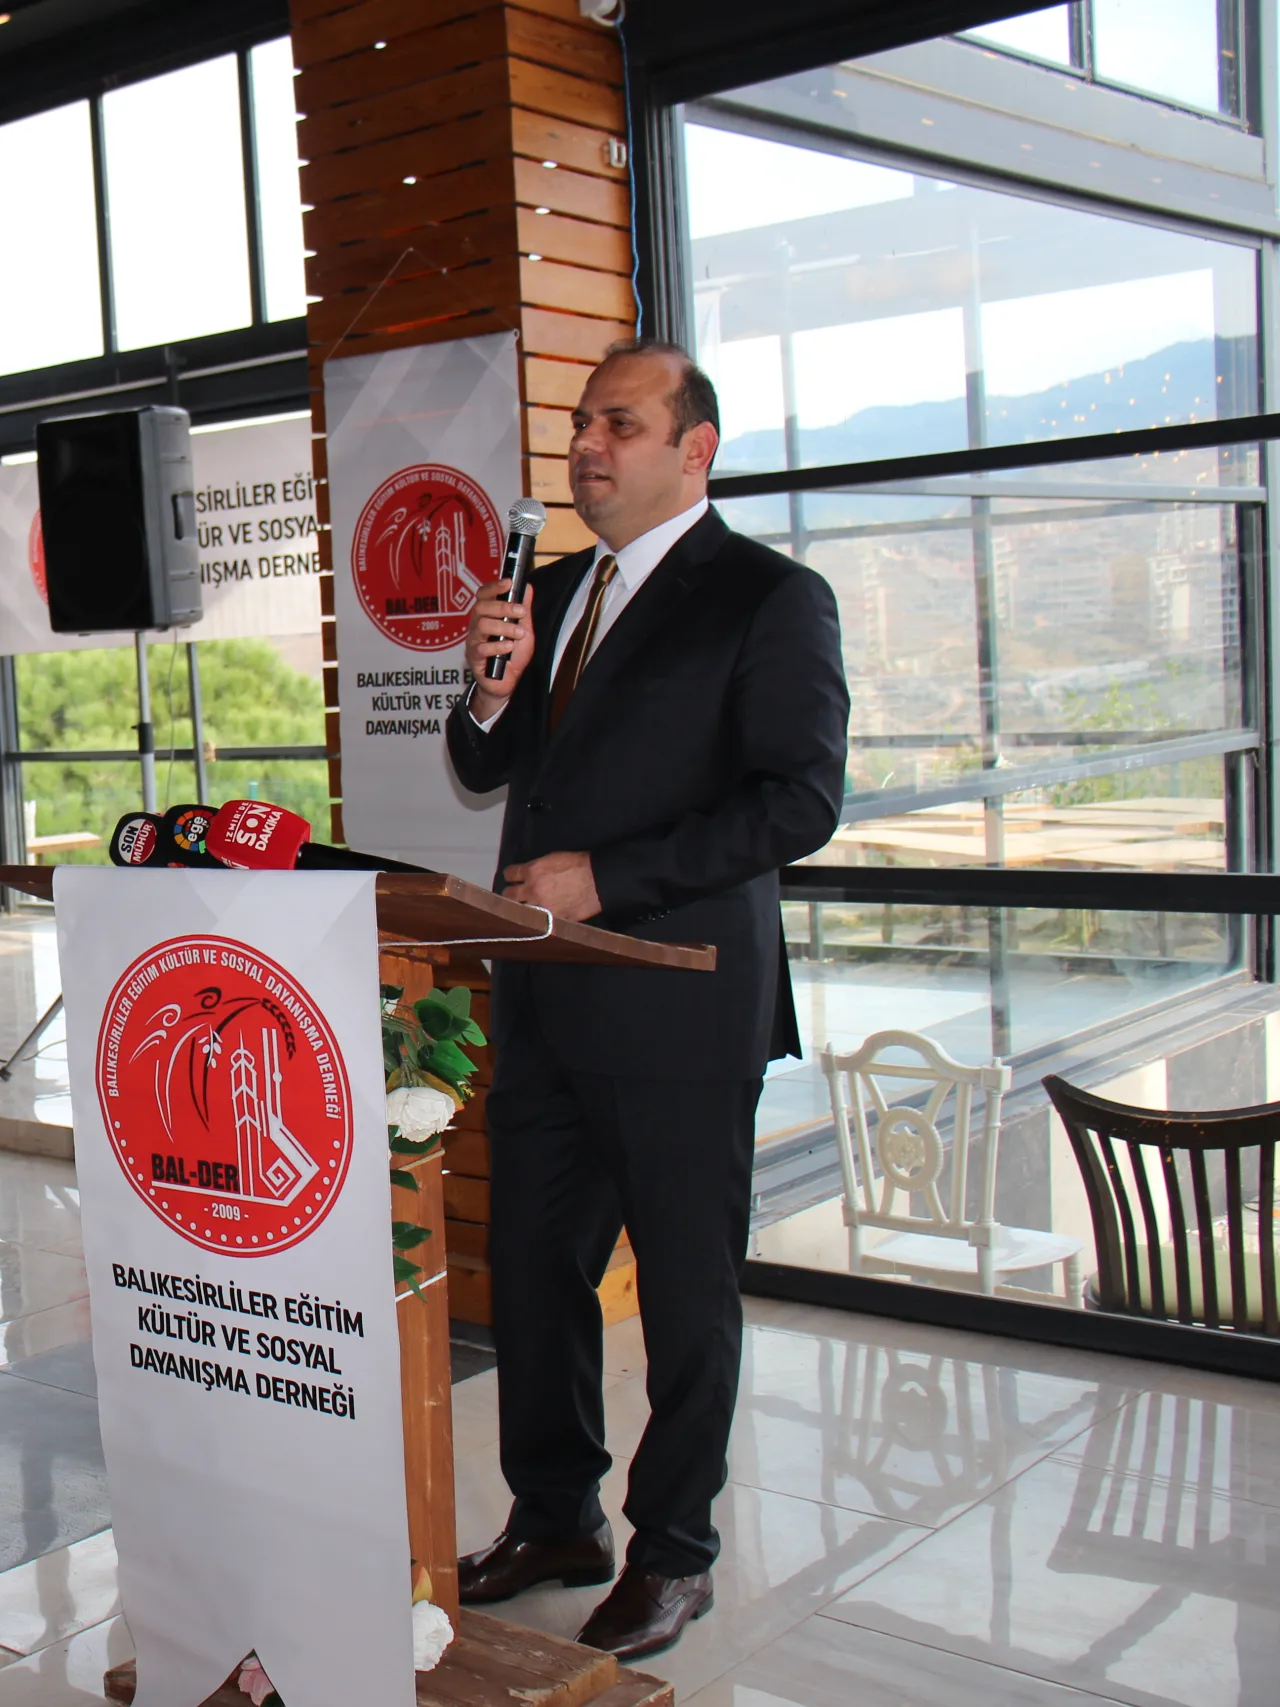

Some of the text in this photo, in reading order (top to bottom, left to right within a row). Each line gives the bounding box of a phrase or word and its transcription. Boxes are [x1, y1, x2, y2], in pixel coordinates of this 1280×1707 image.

[195, 480, 276, 513] SİRLİLER
[228, 522, 253, 545] VE
[258, 515, 318, 541] SOSYA
[258, 551, 320, 578] DERNE
[357, 666, 460, 688] BALIKESİRLİLER
[372, 691, 421, 711] KÜLTÜR
[425, 694, 443, 710] VE
[366, 719, 441, 739] DAYANIŞMA
[121, 825, 139, 853] SON
[188, 816, 203, 841] ege
[254, 811, 283, 851] DAKIKA
[106, 947, 342, 1120] BALIKESİRLİLER EĞİTİM KÜLTÜR VE SOSYAL DAYANIŞMA DERNEĞİ
[151, 1153, 239, 1192] BAL-DER
[211, 1202, 240, 1221] 2009
[112, 1263, 365, 1338] BALIKESİRLİLER EĞİTİM
[138, 1303, 342, 1375] KÜLTÜR VE SOSYAL
[129, 1342, 356, 1420] DAYANIŞMA DERNEĞİ
